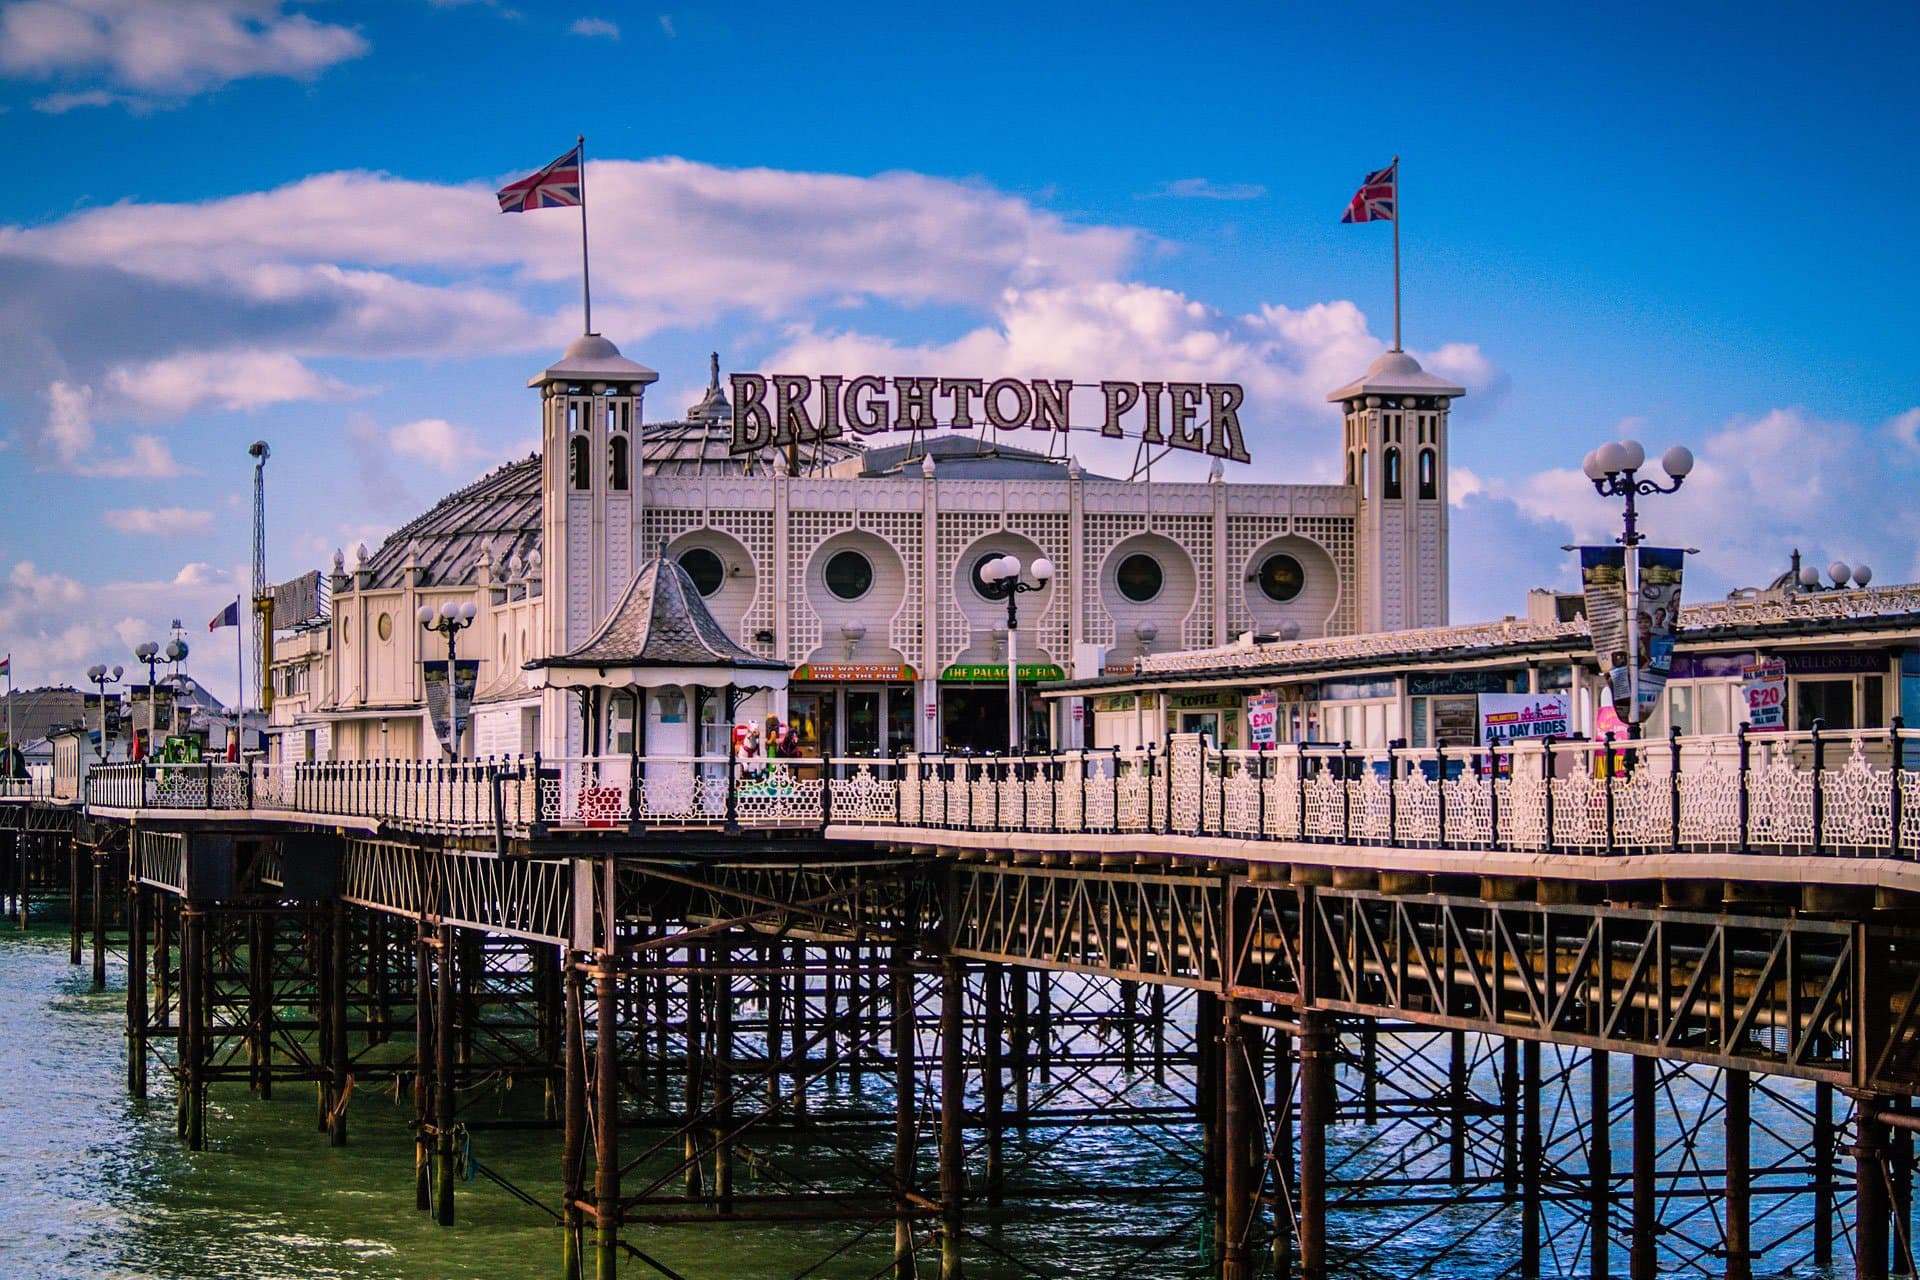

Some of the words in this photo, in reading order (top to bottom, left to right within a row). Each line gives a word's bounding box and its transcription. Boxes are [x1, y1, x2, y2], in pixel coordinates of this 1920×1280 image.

[729, 373, 1073, 455] BRIGHTON
[1101, 381, 1251, 464] PIER
[949, 668, 968, 677] THE
[1018, 668, 1031, 677] OF
[1036, 668, 1057, 677] FUN
[1181, 695, 1218, 706] COFFEE
[1749, 687, 1779, 708] £20
[1253, 712, 1273, 727] £20
[1750, 709, 1760, 717] ALL
[1755, 717, 1765, 725] ALL
[1486, 726, 1506, 739] ALL
[1509, 723, 1530, 737] DAY
[1533, 720, 1566, 735] RIDES
